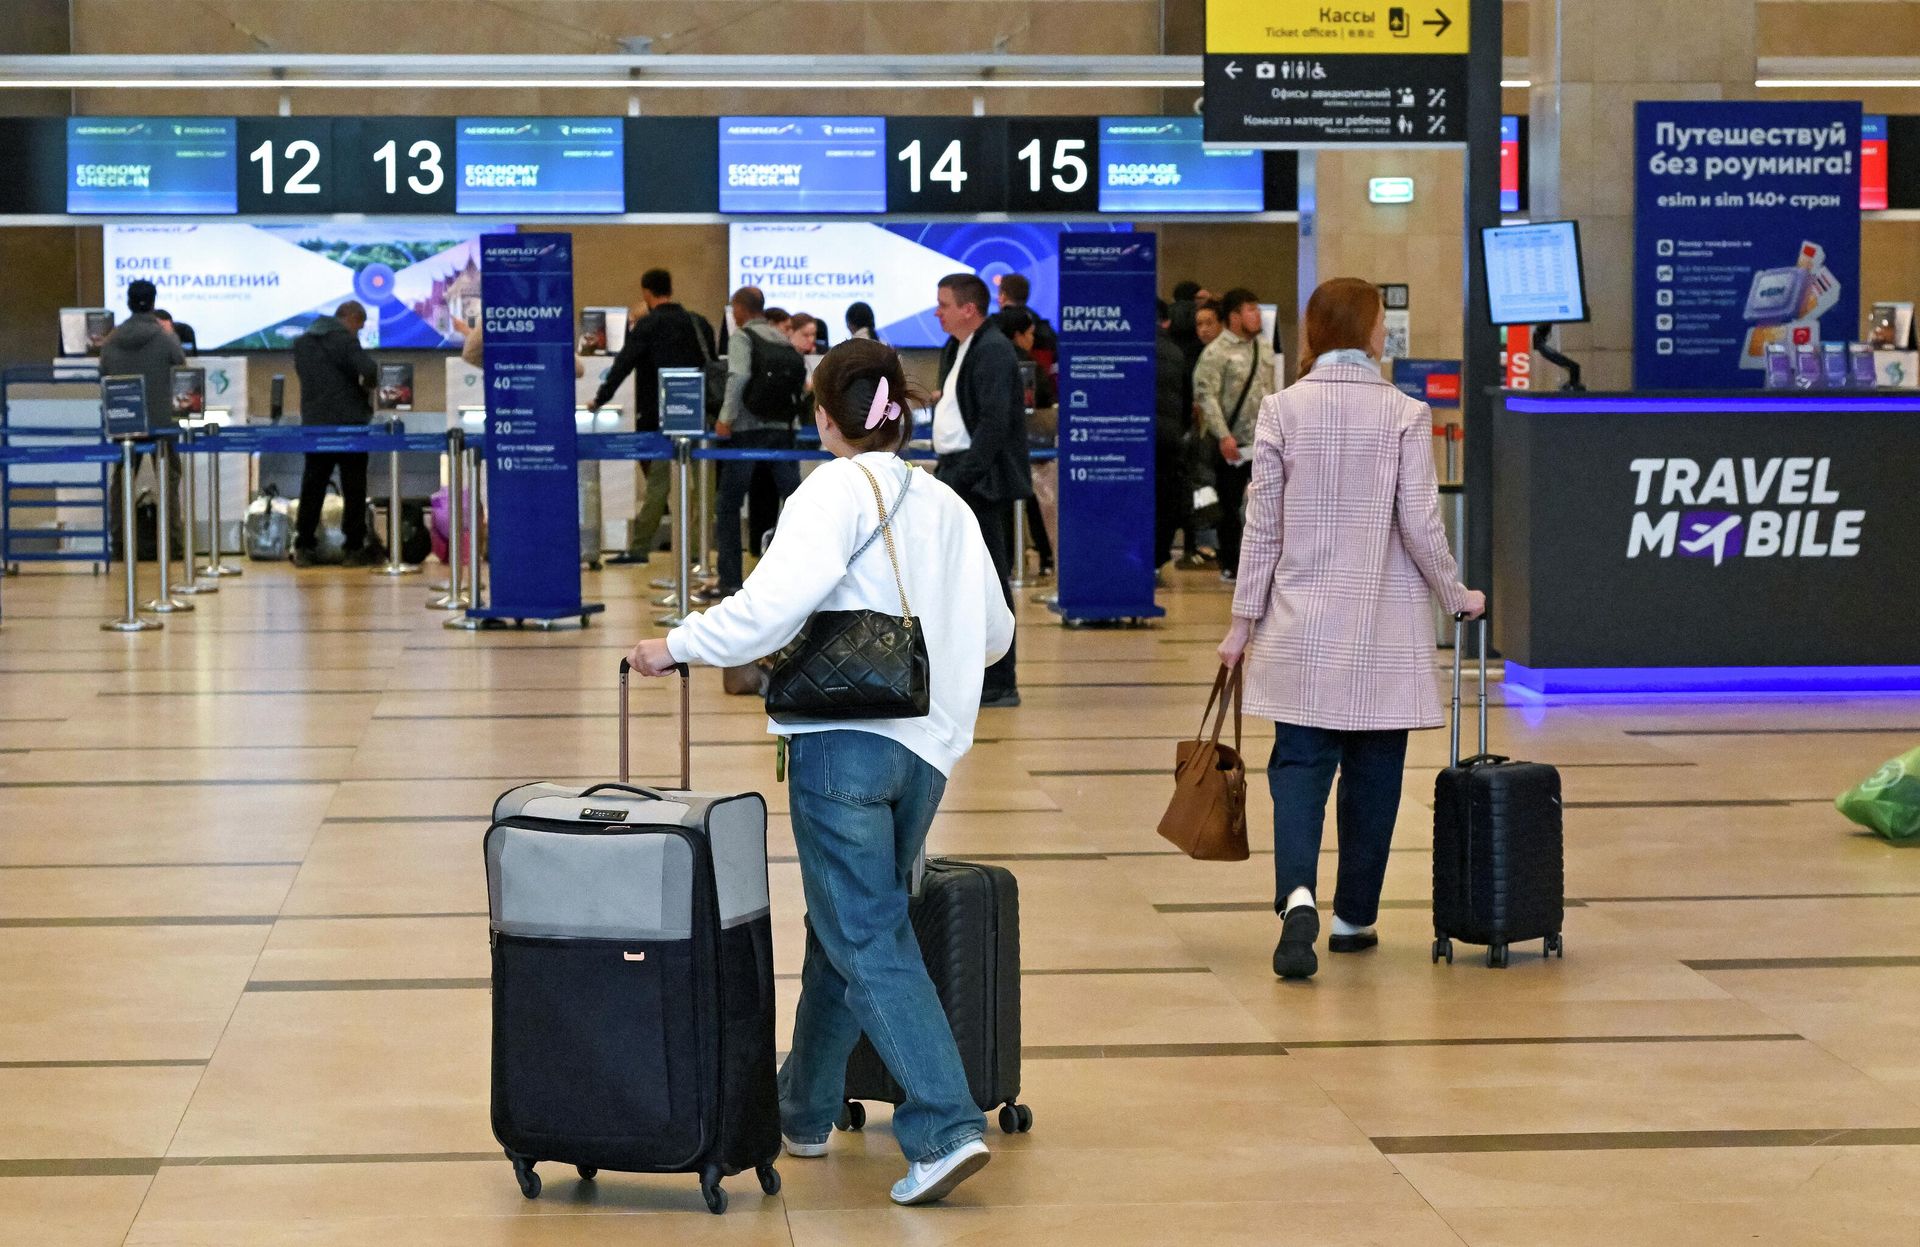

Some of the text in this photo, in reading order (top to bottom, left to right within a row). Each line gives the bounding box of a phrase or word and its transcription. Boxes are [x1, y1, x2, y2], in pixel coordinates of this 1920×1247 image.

[1319, 7, 1376, 22] Кассы
[1265, 27, 1299, 37] Ticket
[1302, 27, 1338, 37] offices
[1271, 87, 1391, 99] Офисы авиакомпаний
[1243, 114, 1291, 125] Комната
[1293, 116, 1334, 127] матери
[1335, 117, 1343, 125] и
[1656, 121, 1847, 151] Путешествуй
[76, 165, 151, 175] ECONOMY
[250, 139, 321, 194] 12
[373, 139, 444, 195] 13
[465, 165, 540, 175] ECONOMY
[728, 164, 802, 175] ECONOMY
[898, 139, 968, 193] 14
[1018, 138, 1088, 193] 15
[1108, 163, 1178, 174] BAGGAGE
[1649, 151, 1853, 181] без роуминга!
[76, 175, 150, 187] CHECK-IN
[465, 175, 537, 187] CHECK-IN
[728, 175, 800, 186] CHECK-IN
[1108, 174, 1182, 186] DROP-OFF
[1657, 191, 1841, 210] esim и sim 140+ стран
[115, 256, 172, 269] БОЛЕЕ
[740, 255, 808, 269] СЕРДЦЕ
[740, 271, 875, 286] ПУТЕШЕСТВИЙ
[485, 306, 563, 319] ECONOMY
[1063, 305, 1122, 318] ПРИЕМ
[485, 320, 536, 332] CLASS
[1063, 319, 1132, 332] БАГАЖА
[493, 376, 511, 390] 40
[494, 420, 512, 434] 20
[1069, 428, 1088, 442] 23
[497, 457, 513, 471] 10
[1070, 467, 1087, 481] 10
[1629, 457, 1840, 505] TRAVEL
